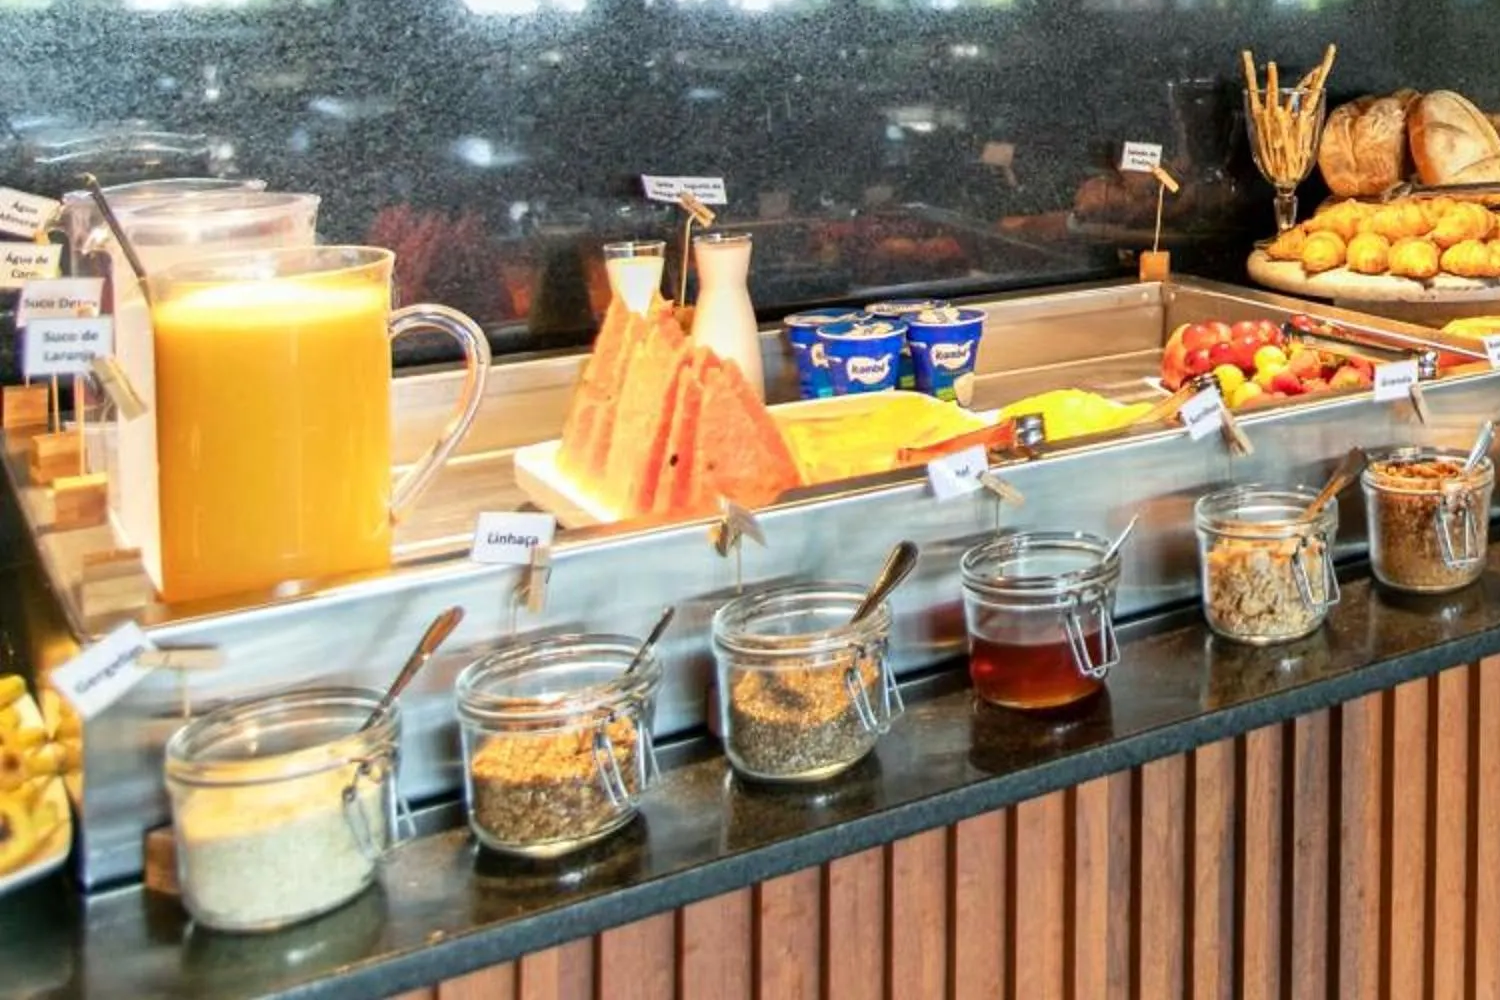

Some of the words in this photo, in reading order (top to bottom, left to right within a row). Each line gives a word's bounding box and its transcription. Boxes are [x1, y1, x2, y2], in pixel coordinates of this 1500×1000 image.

[42, 330, 78, 343] Suco
[80, 329, 99, 341] de
[487, 532, 540, 548] Linhaça
